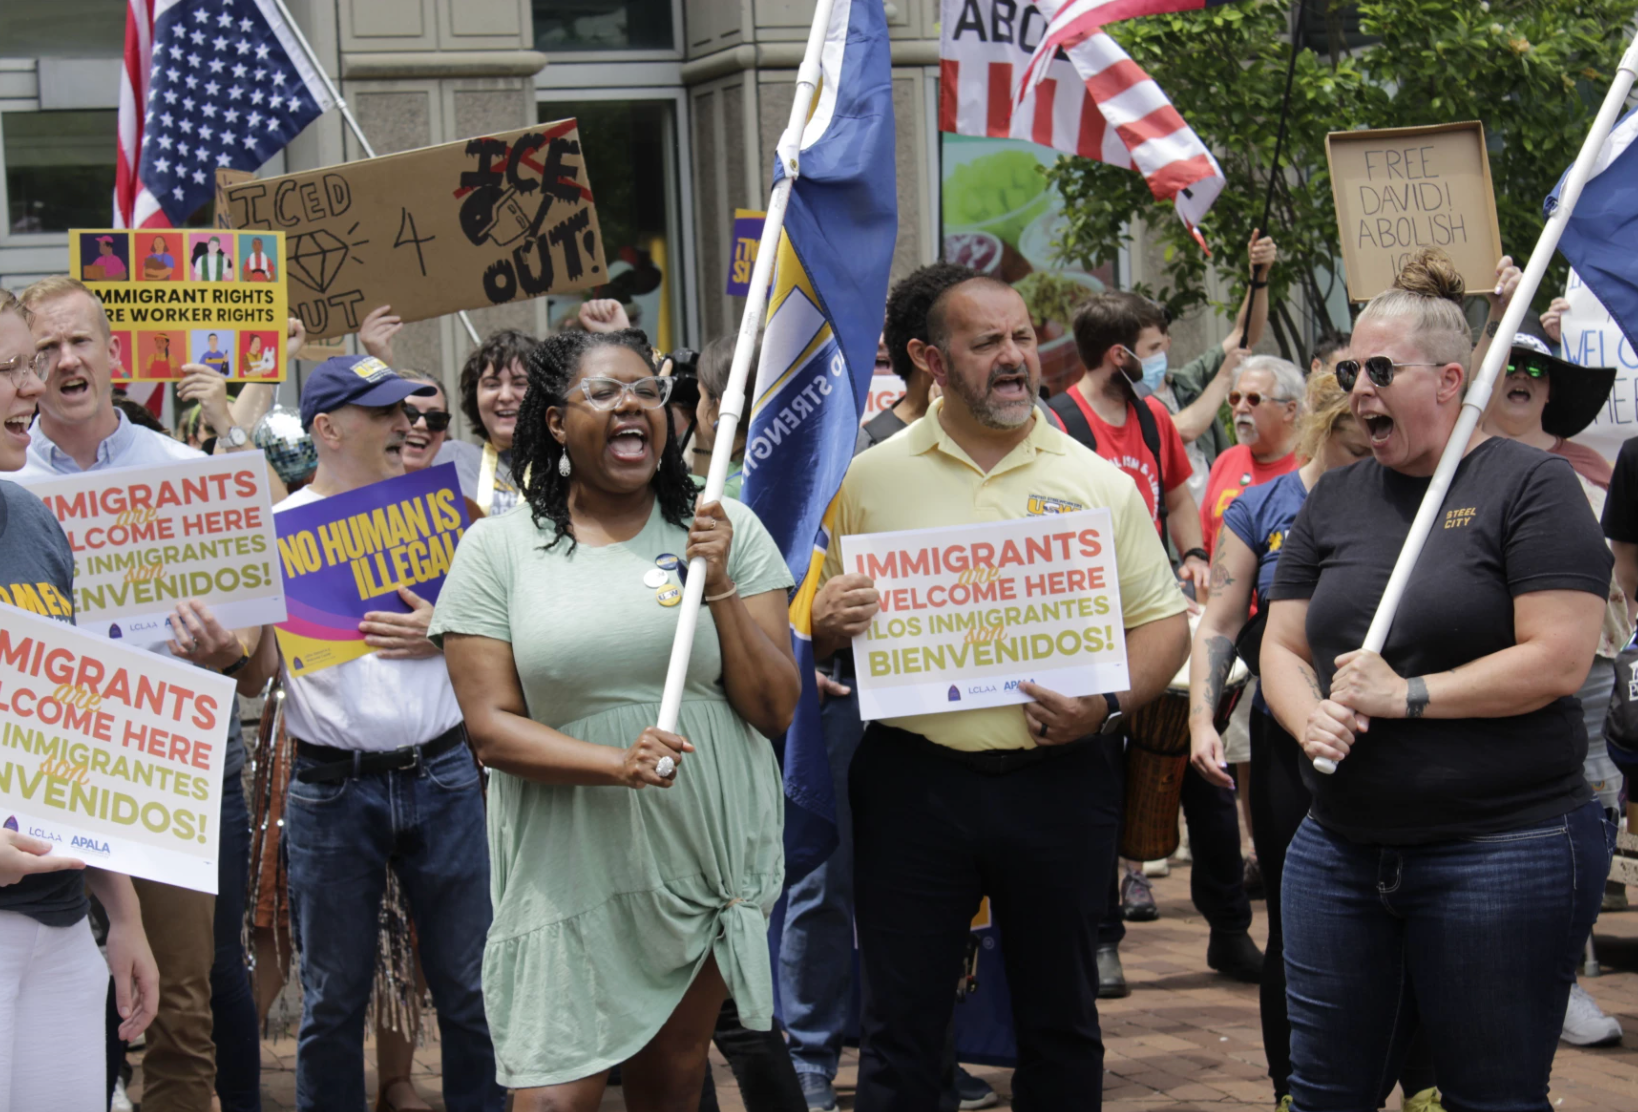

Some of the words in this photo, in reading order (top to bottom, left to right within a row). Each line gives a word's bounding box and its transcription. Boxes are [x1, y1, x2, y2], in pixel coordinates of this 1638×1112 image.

[953, 0, 1071, 62] ABO
[460, 132, 582, 206] ICE
[1364, 145, 1439, 182] FREE
[229, 173, 351, 230] ICED
[1359, 182, 1453, 215] DAVID!
[393, 207, 435, 277] 4
[1359, 213, 1467, 248] ABOLISH
[482, 207, 600, 305] OUT!
[94, 288, 208, 304] MMIGRANT
[213, 289, 274, 304] RIGHTS
[288, 288, 365, 334] UT
[104, 308, 125, 322] RE
[130, 308, 212, 322] WORKER
[217, 308, 274, 322] RIGHTS
[42, 470, 257, 522] MIGRANTS
[1446, 507, 1476, 519] STEEL
[67, 518, 175, 552] LCOME
[182, 506, 262, 537] HERE
[115, 506, 159, 528] are
[276, 530, 322, 579] NO
[317, 496, 431, 567] HUMAN
[425, 488, 461, 534] IS
[1444, 517, 1471, 529] CITY
[86, 534, 267, 576] INMIGRANTES
[856, 529, 1102, 581] IMMIGRANTS
[124, 563, 167, 584] son
[958, 565, 1001, 587] are
[1025, 566, 1106, 598] HERE
[129, 621, 159, 632] LCLAA
[929, 595, 1110, 635] INMIGRANTES
[868, 625, 1115, 677] BIENVENIDOS!
[963, 624, 1008, 645] son
[53, 683, 101, 713] are
[968, 684, 997, 694] LCLAA
[2, 721, 210, 802] INMIGRANTES
[122, 719, 213, 771] HERE
[39, 753, 90, 786] son
[29, 826, 62, 843] LCLAA
[70, 835, 111, 854] APALA
